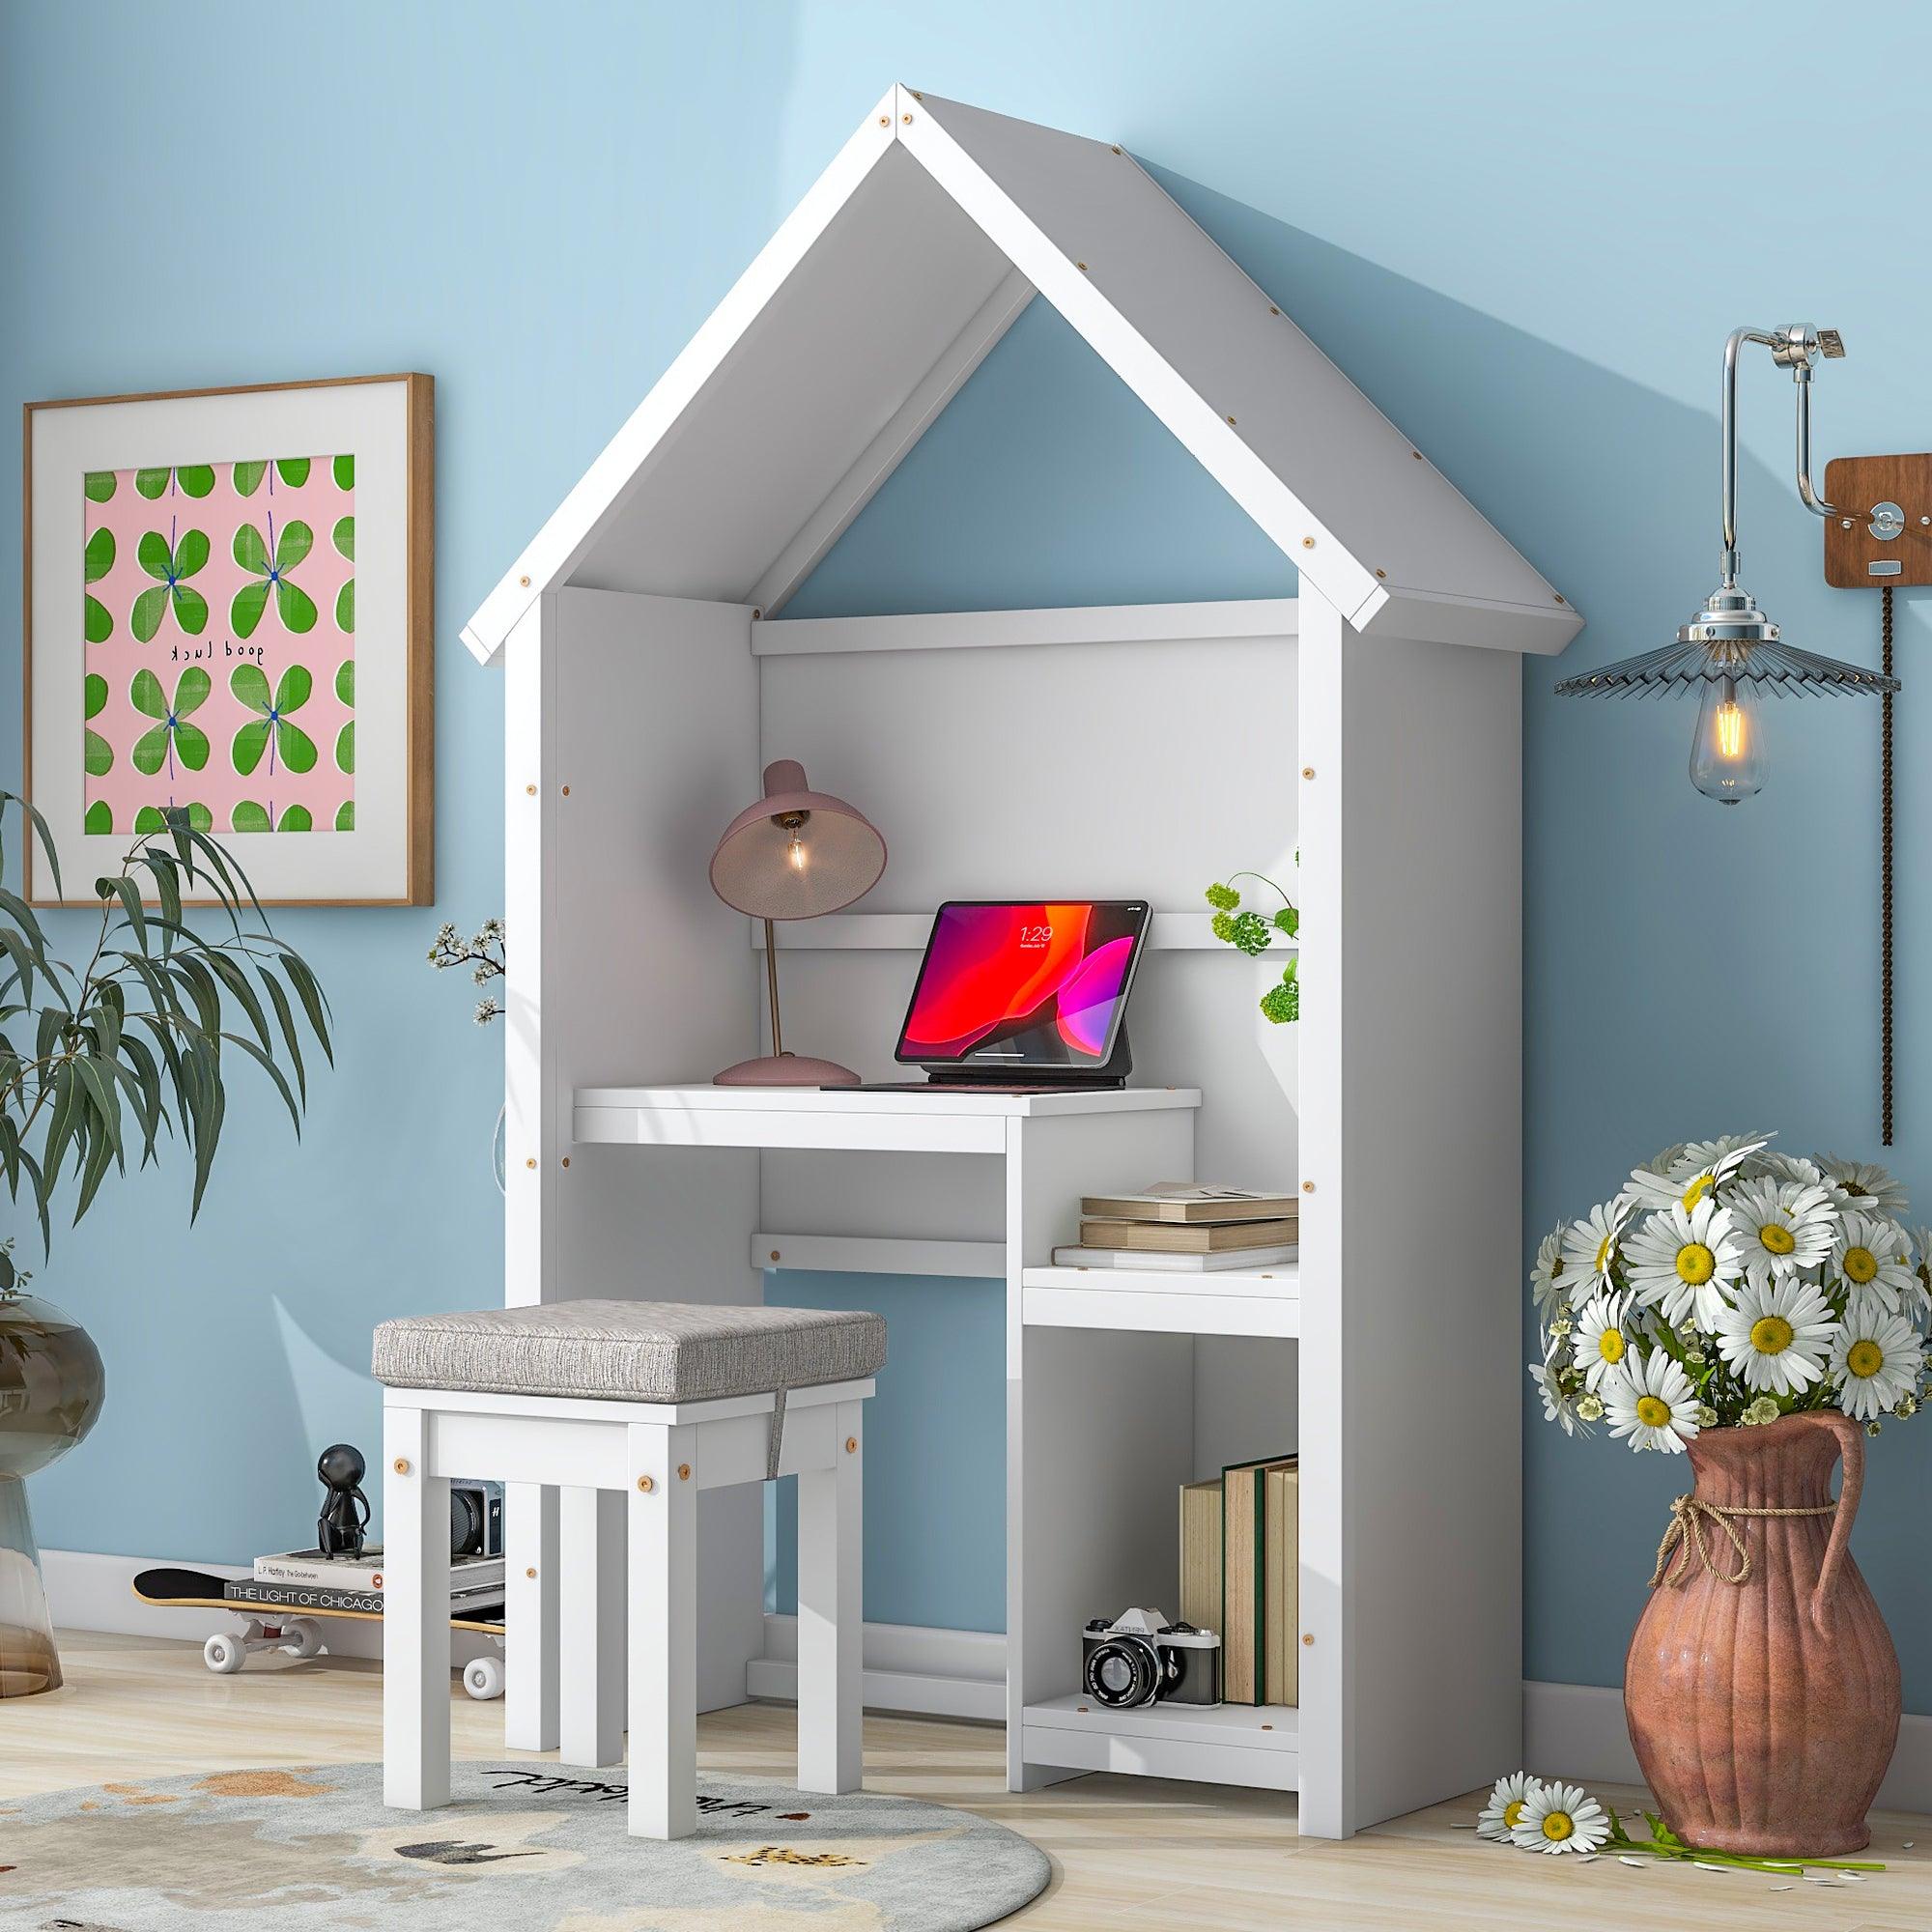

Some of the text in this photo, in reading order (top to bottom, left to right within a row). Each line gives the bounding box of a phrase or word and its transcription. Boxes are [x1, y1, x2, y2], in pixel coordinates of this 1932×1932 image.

[1020, 926, 1053, 942] 1:29
[231, 1586, 384, 1611] THE LIGHT OF CHICAGO
